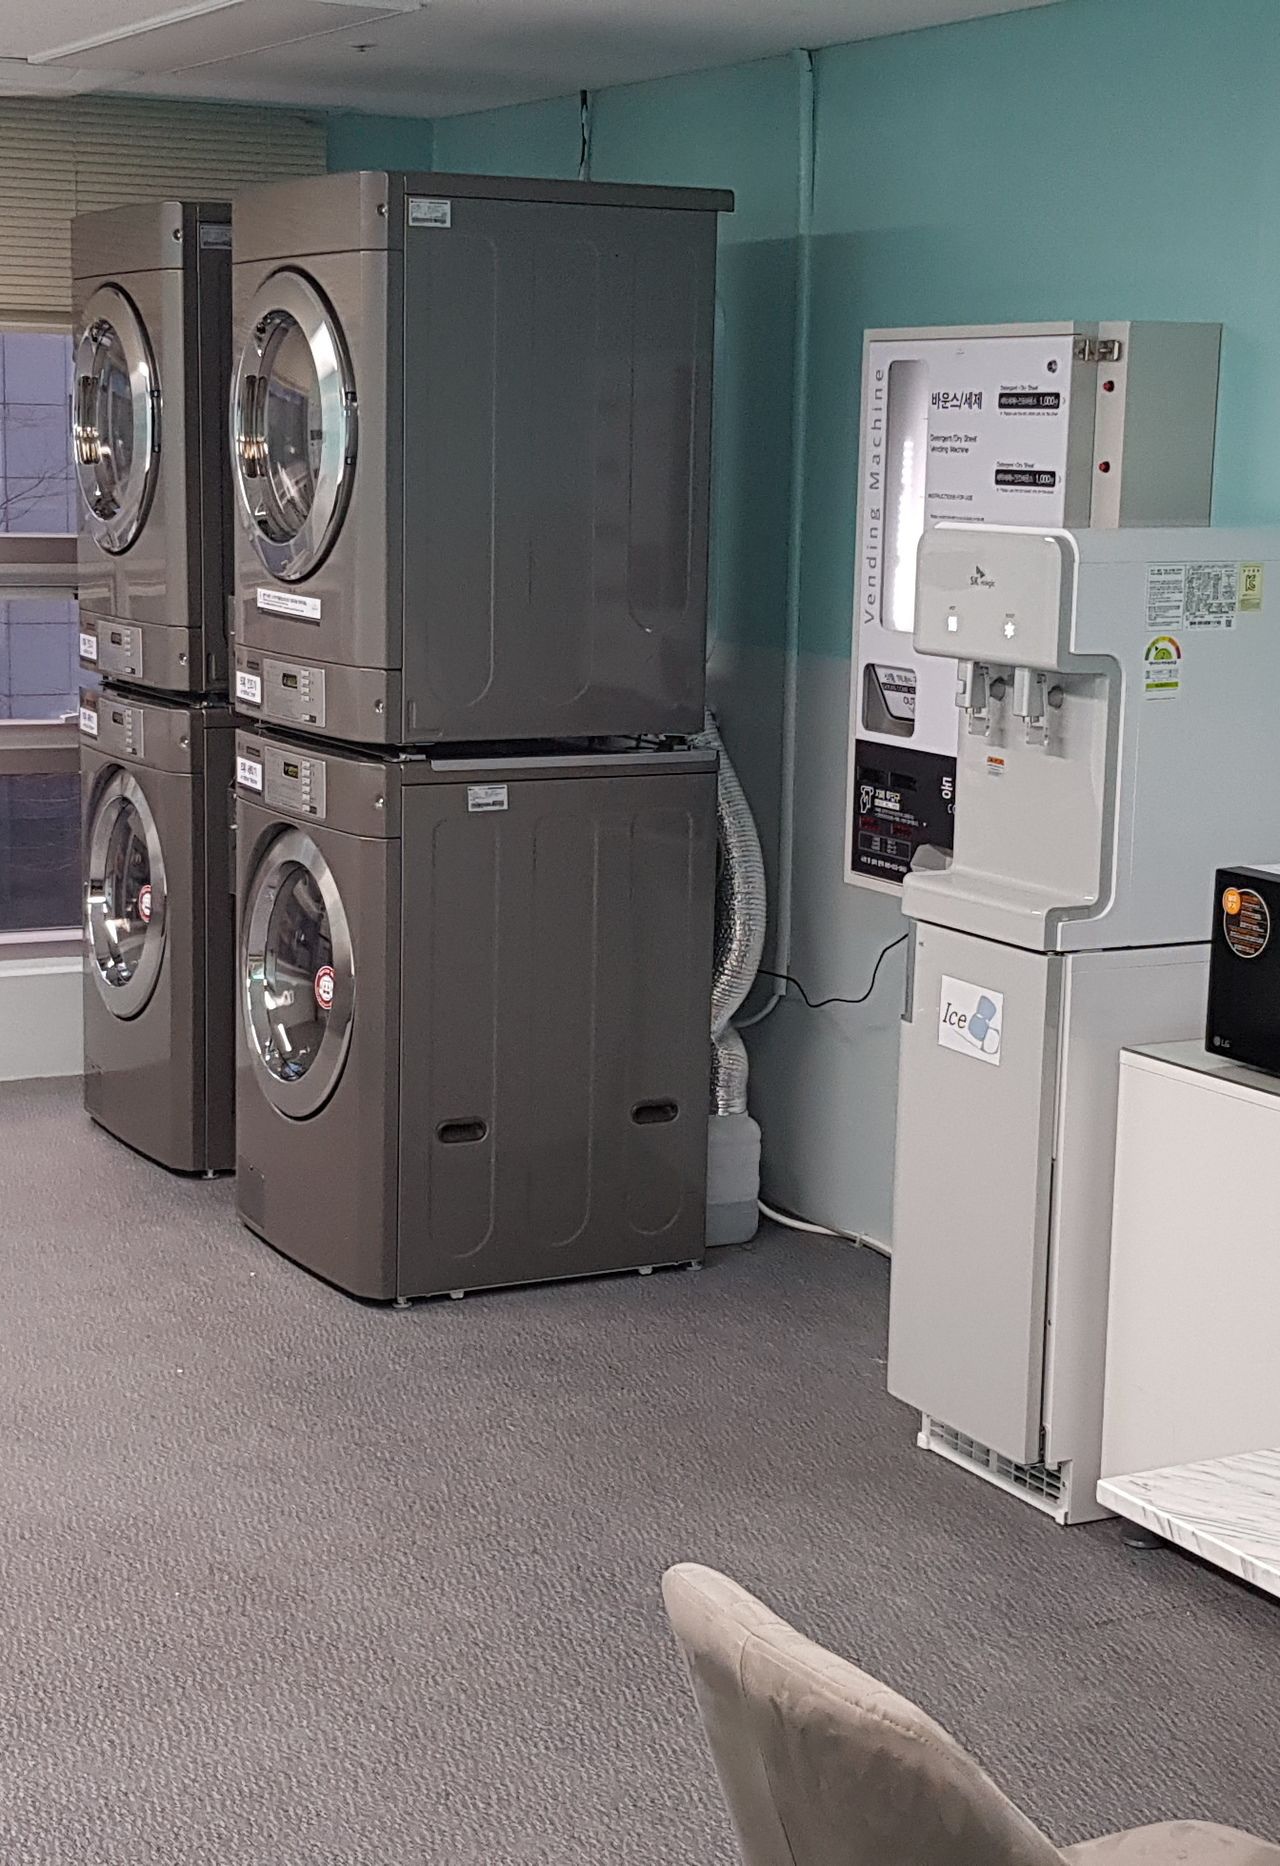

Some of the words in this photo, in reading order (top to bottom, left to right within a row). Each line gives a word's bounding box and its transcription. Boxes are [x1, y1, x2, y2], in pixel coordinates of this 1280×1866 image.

[931, 391, 983, 410] 바운스/세제
[869, 368, 885, 490] Machine
[863, 507, 881, 625] Vending
[970, 575, 979, 586] SK
[942, 1002, 967, 1029] Ice
[1221, 1038, 1231, 1048] LG
